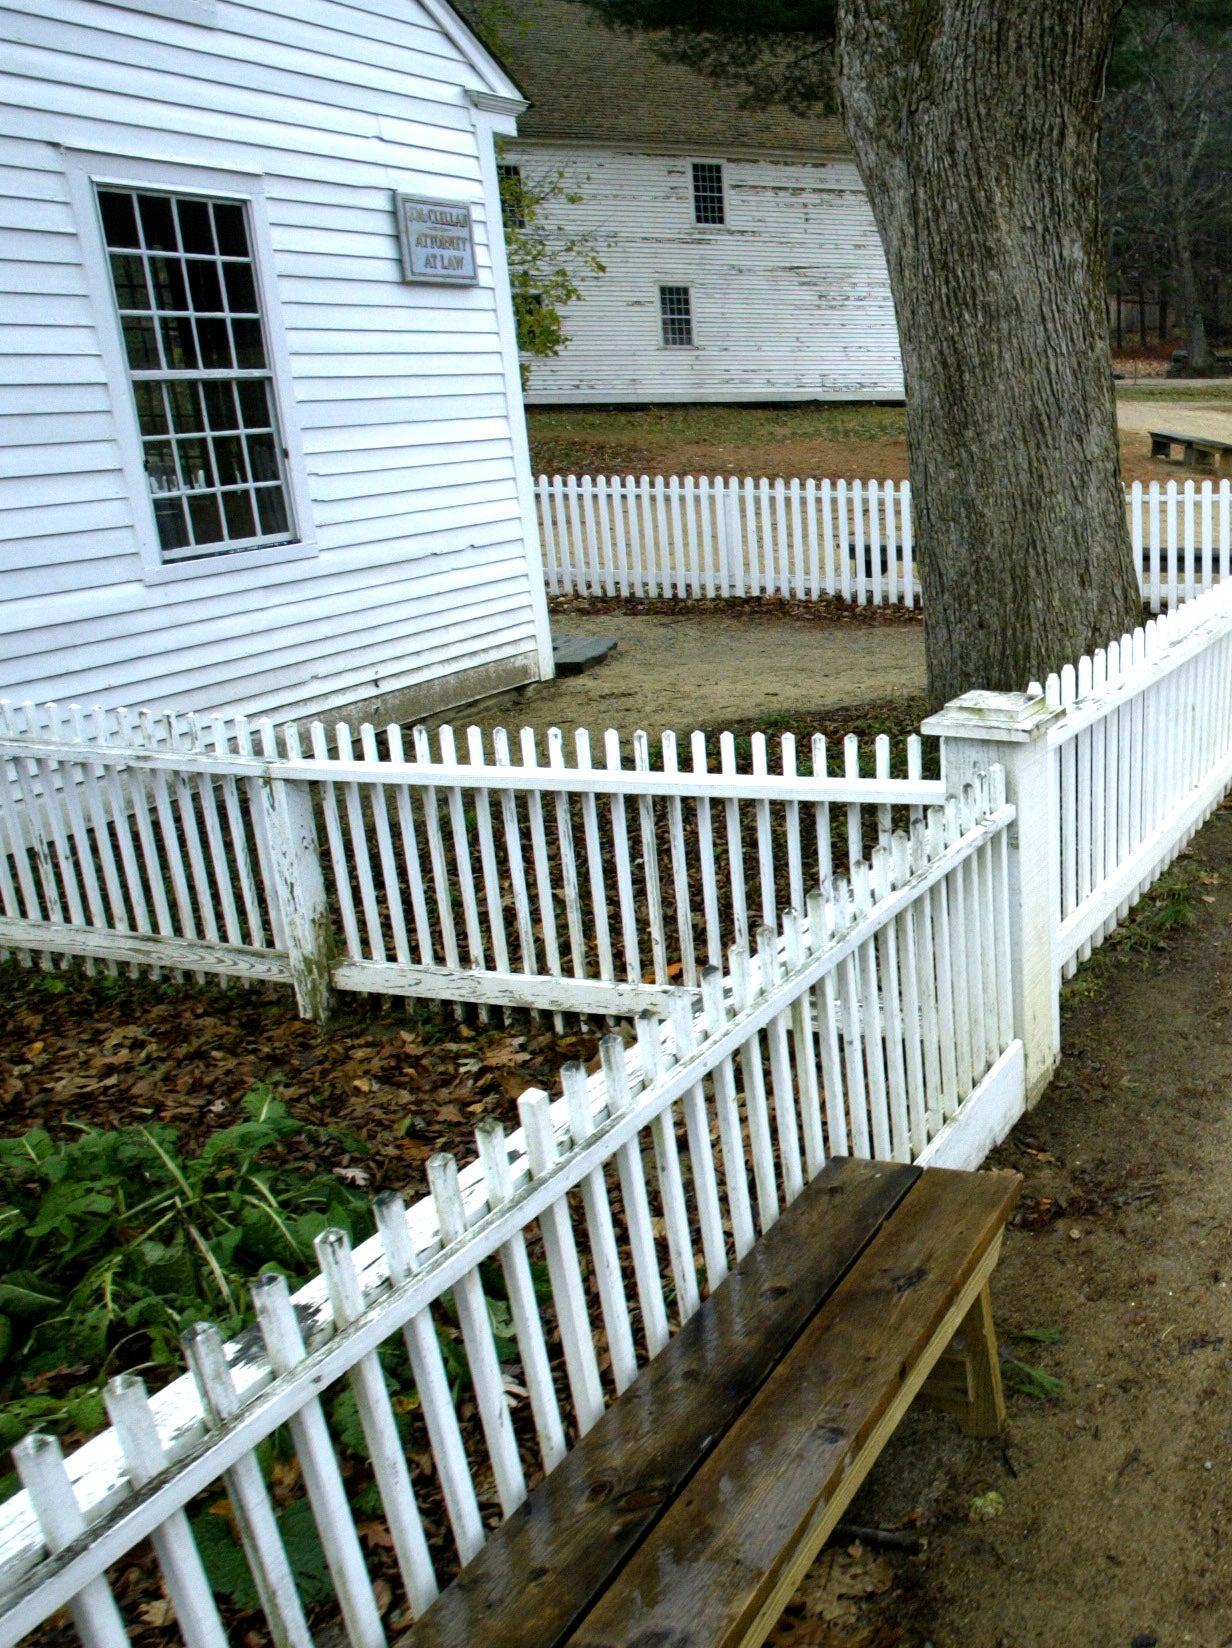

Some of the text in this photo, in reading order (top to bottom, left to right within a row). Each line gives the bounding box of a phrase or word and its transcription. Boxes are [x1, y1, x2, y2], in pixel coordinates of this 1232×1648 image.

[415, 232, 468, 252] ATTORNEY
[424, 253, 464, 271] AT LAW
